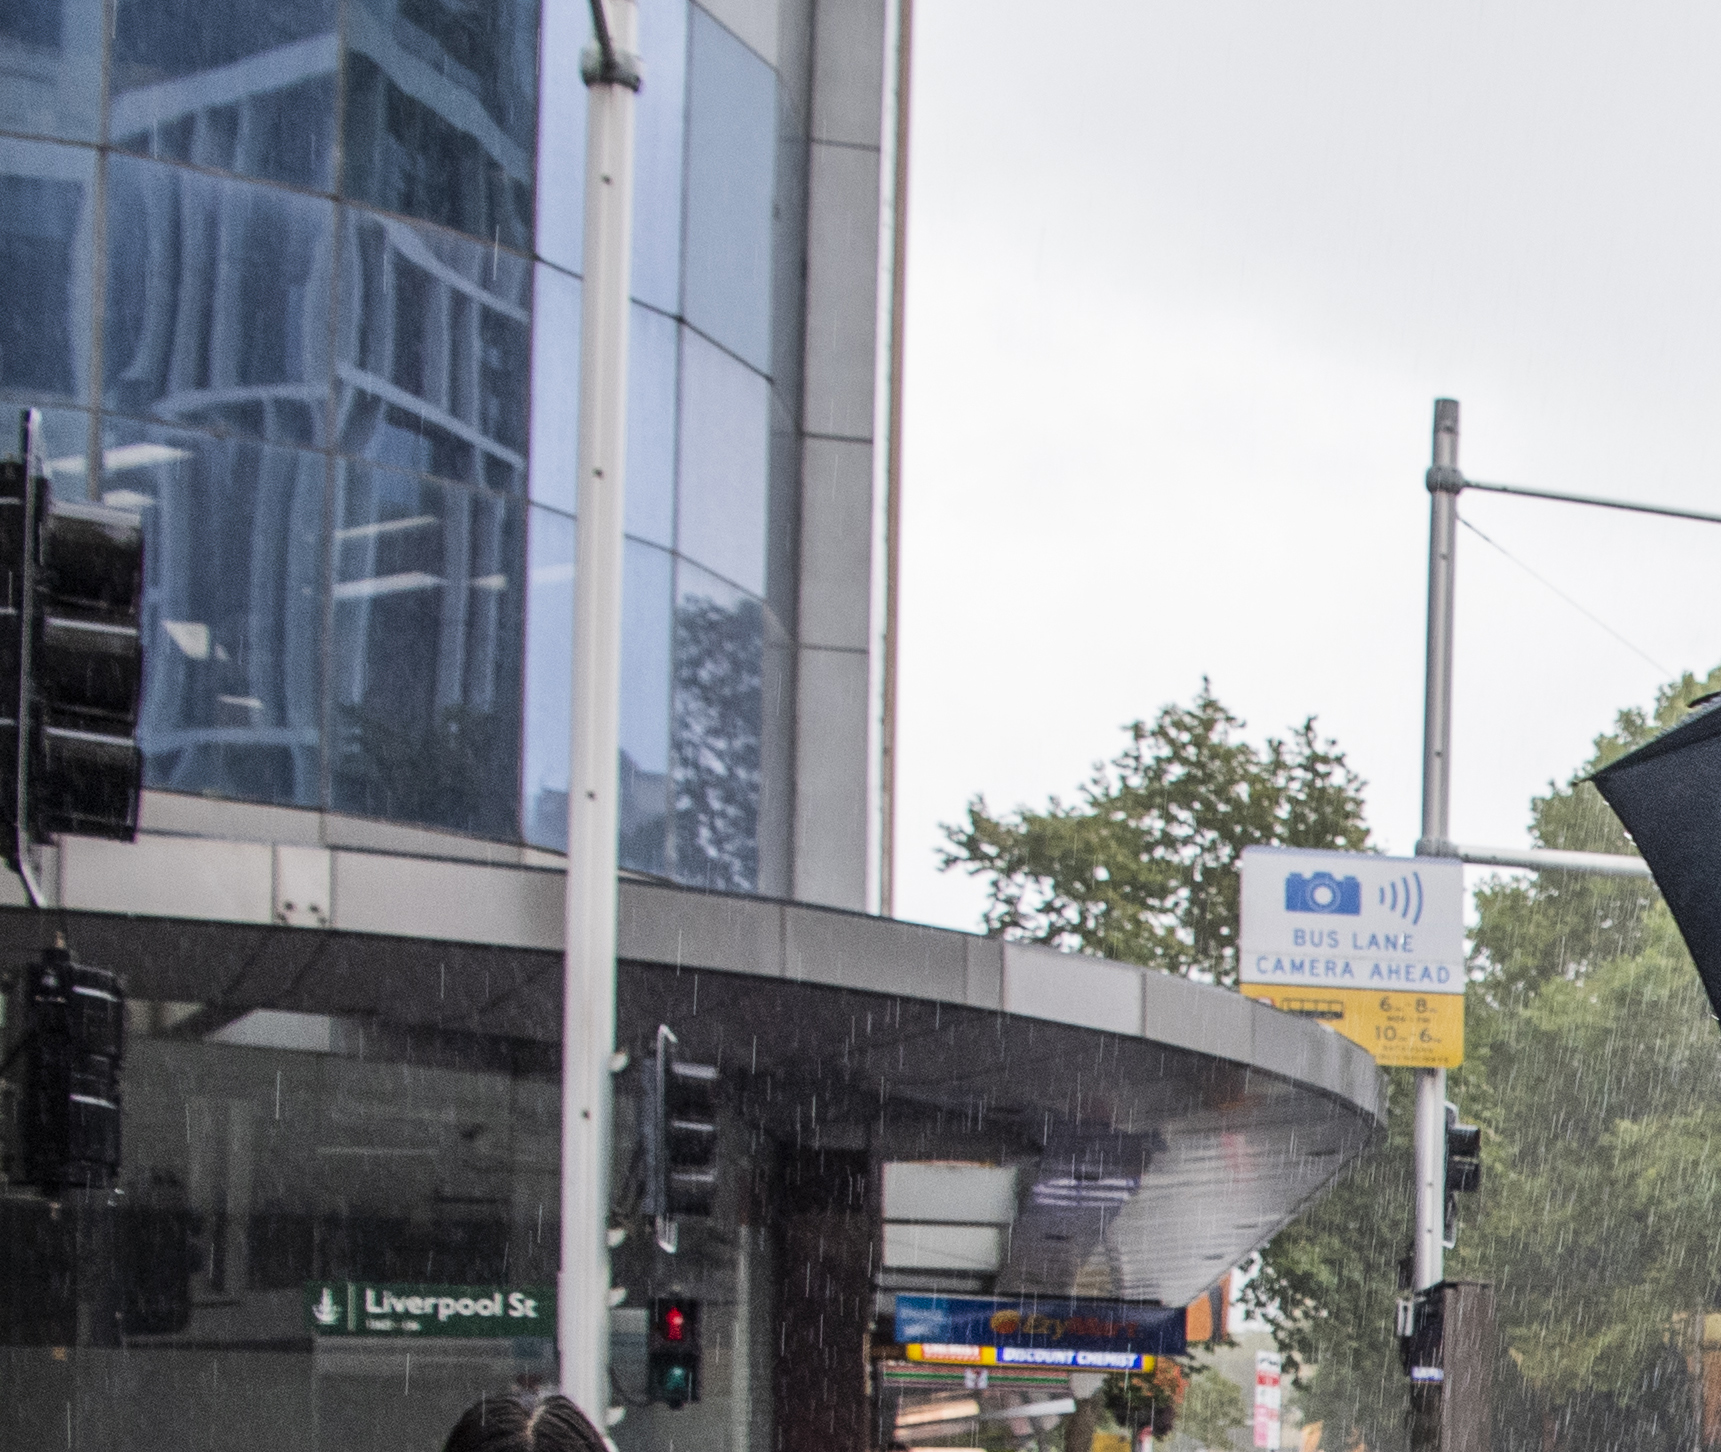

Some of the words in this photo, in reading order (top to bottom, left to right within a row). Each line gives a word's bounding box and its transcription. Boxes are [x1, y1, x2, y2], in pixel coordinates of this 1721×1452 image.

[1293, 928, 1339, 949] BUS
[1352, 932, 1414, 953] LANE
[1256, 955, 1355, 979] CAMERA
[1369, 963, 1450, 984] AHEAD
[365, 1287, 504, 1321] Liverpool
[508, 1292, 538, 1317] St
[1002, 1347, 1076, 1365] DISCOUNT
